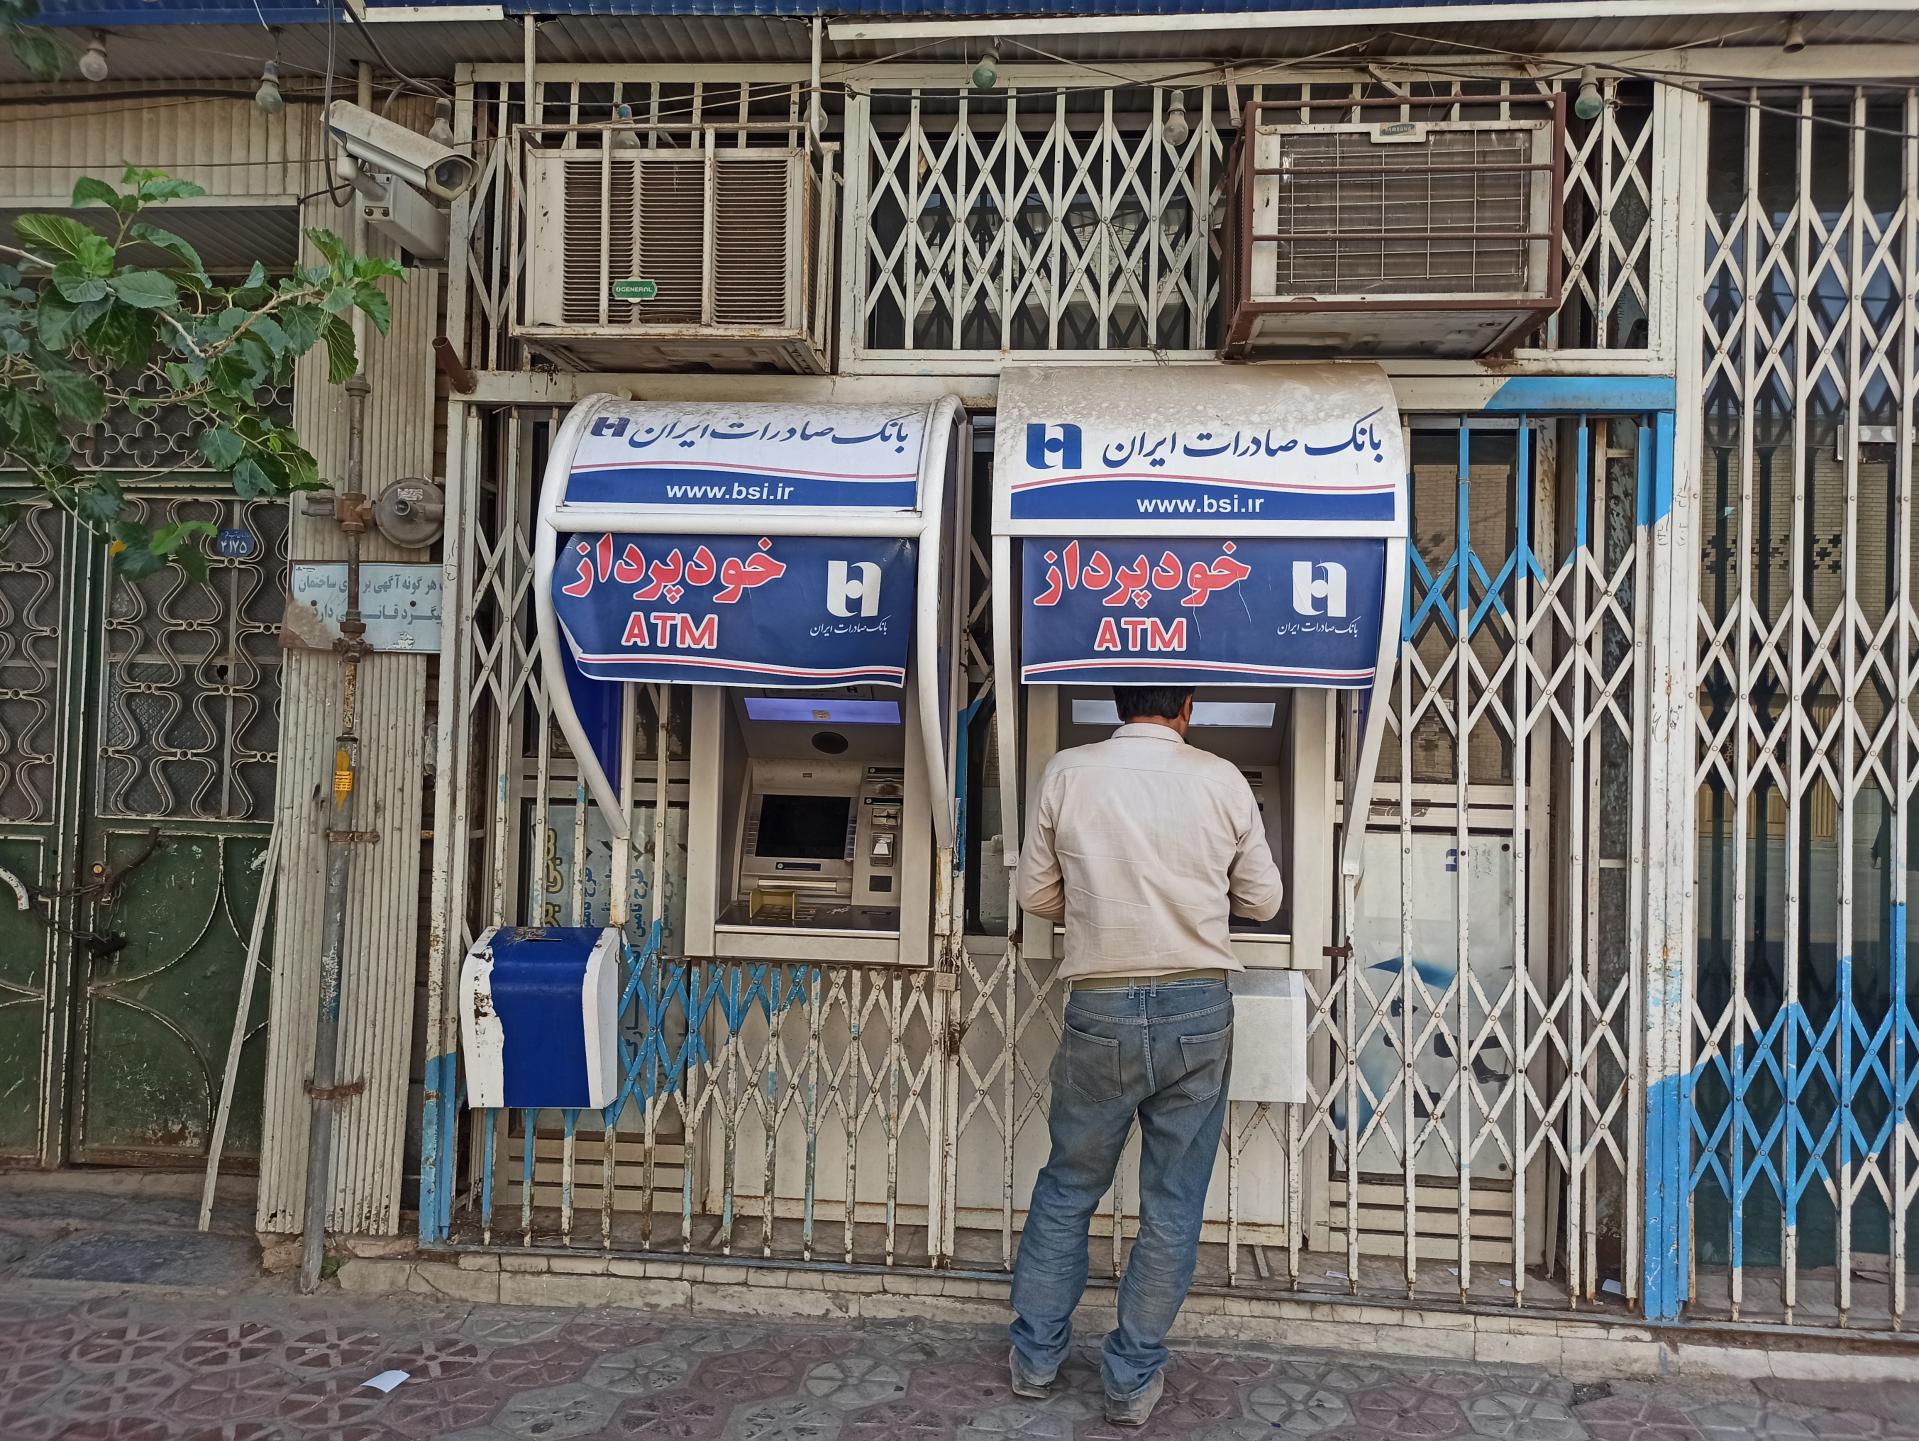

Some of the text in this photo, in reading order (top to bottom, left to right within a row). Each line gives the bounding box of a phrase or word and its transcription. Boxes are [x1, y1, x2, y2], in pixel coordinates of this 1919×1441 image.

[628, 411, 920, 454] بانک صادرات ایران
[1102, 406, 1384, 469] بانک صادرات ایران
[666, 482, 795, 501] www.bsi.ir
[298, 575, 336, 593] ساختمان
[402, 574, 423, 595] گونه
[424, 579, 437, 596] هر
[401, 604, 442, 625] یگرد
[621, 611, 719, 650] ATM
[809, 615, 892, 637] بانک صادرات ایران
[1094, 617, 1187, 651] ATM
[1277, 616, 1362, 638] بانک صادرات ایران
